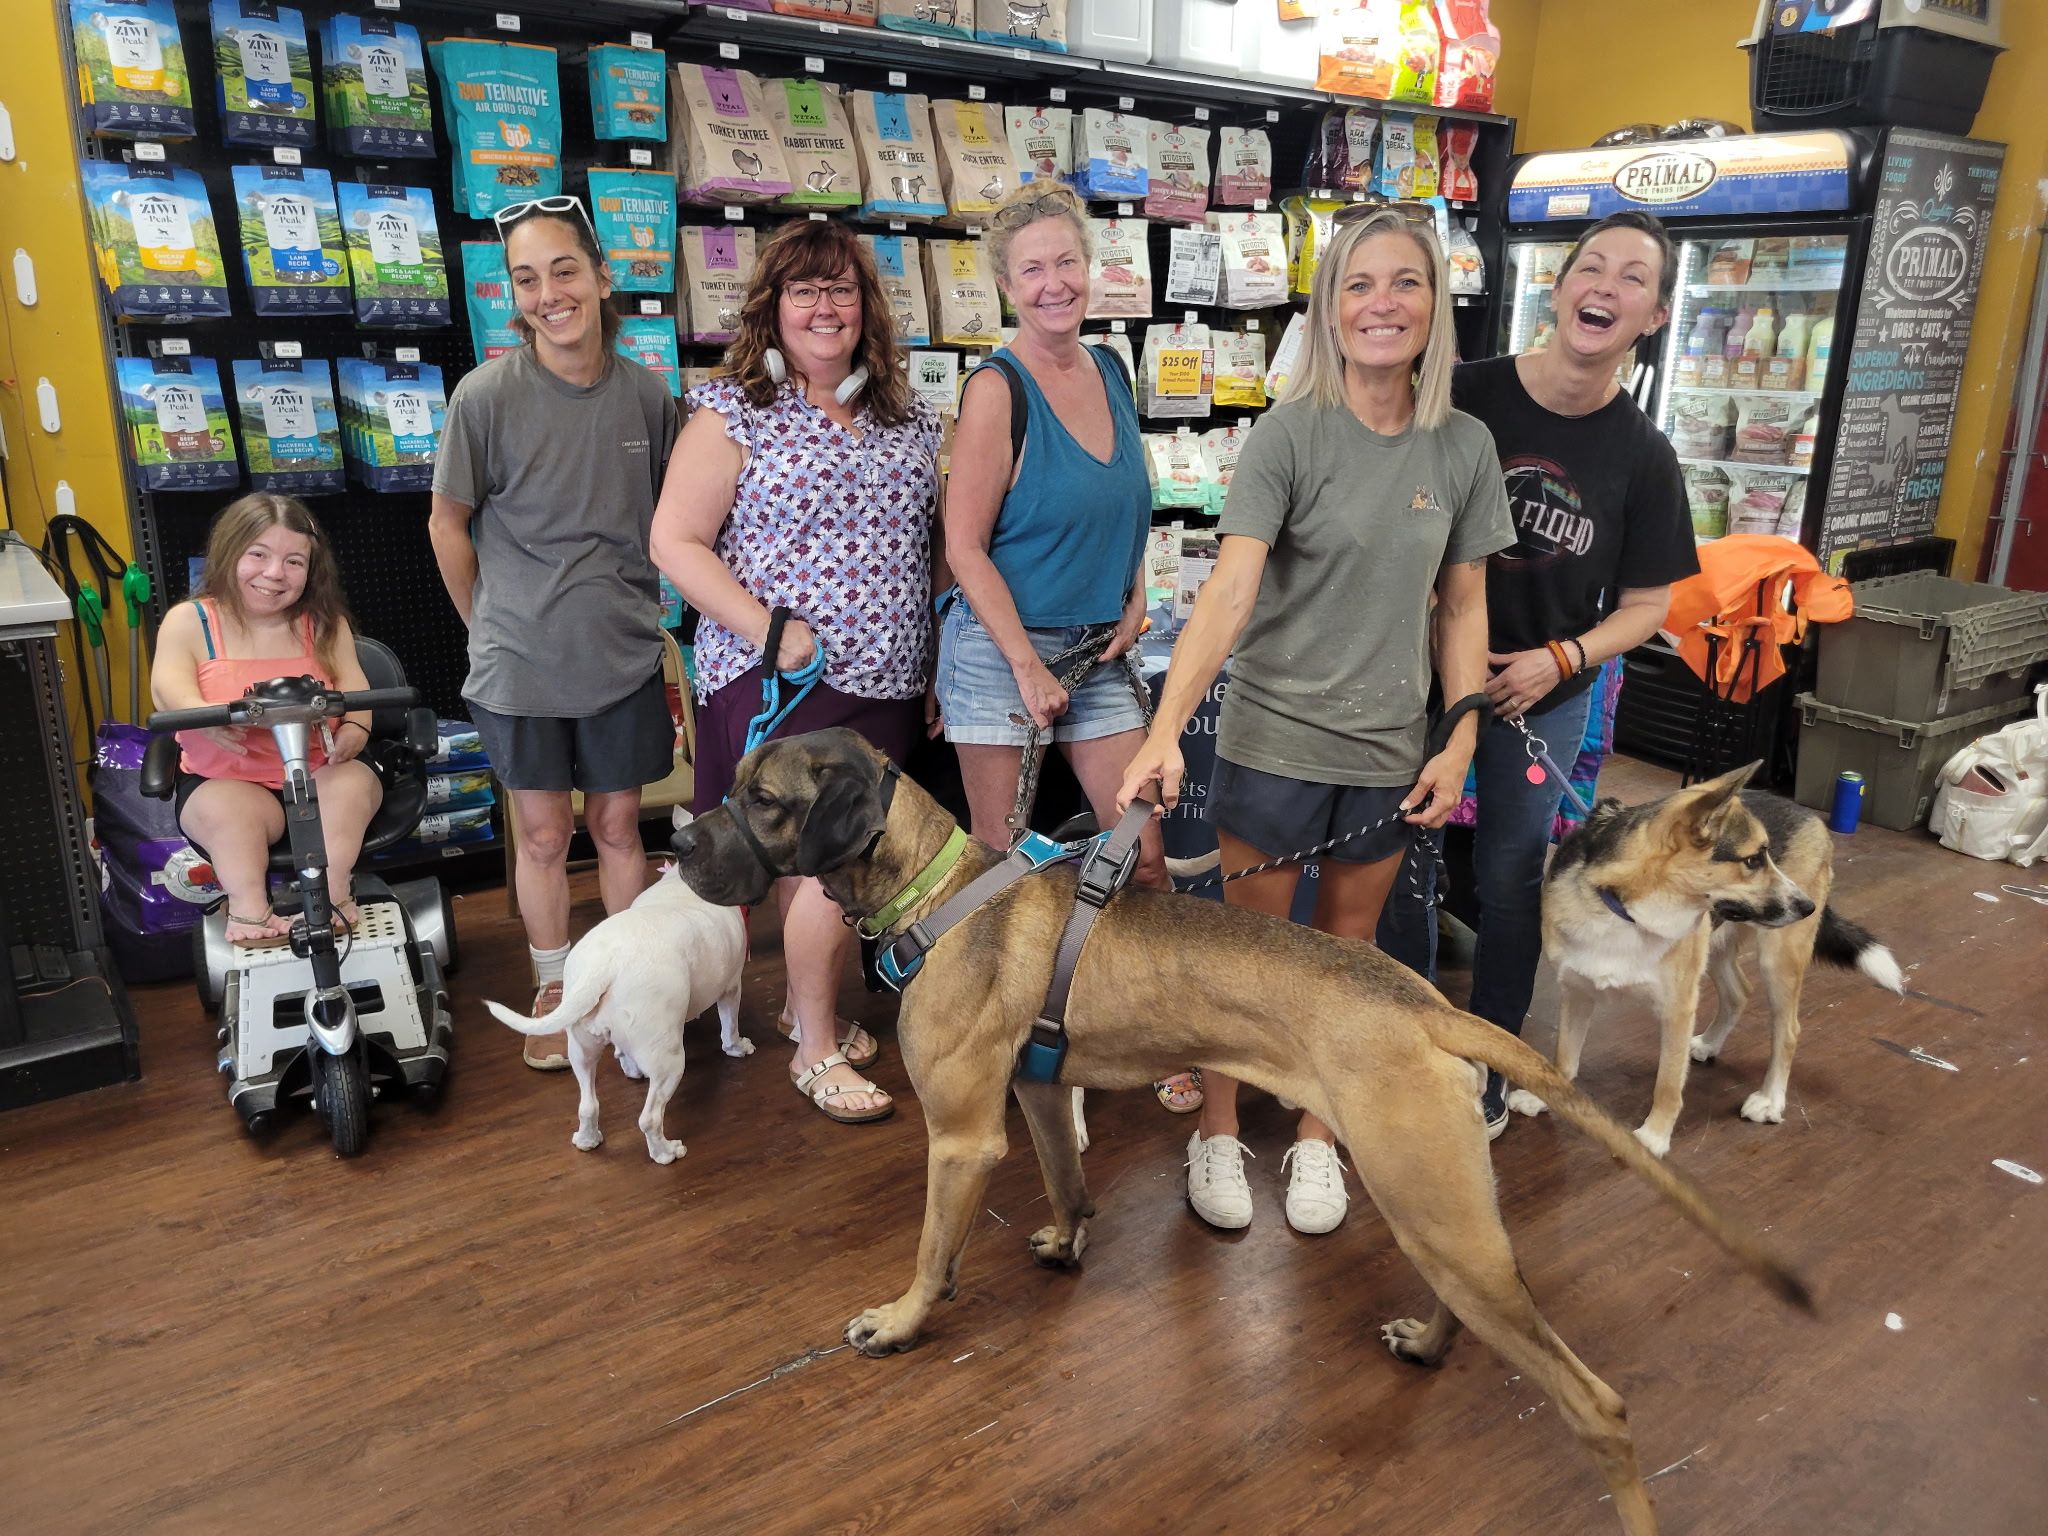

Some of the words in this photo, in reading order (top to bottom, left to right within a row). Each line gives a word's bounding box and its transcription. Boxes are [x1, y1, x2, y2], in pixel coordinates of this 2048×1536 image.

[113, 25, 149, 37] ZIWI
[122, 37, 144, 45] Peak
[247, 40, 279, 52] ZIWI
[254, 52, 274, 60] Peak
[367, 55, 397, 67] ZIWI
[375, 66, 393, 74] Peak
[457, 81, 549, 106] RAWTERNATIVE
[475, 102, 490, 112] AIR
[492, 102, 516, 115] DRIED
[517, 104, 537, 117] FOOD
[717, 102, 742, 110] VITAL
[707, 123, 736, 139] TURKEY
[738, 129, 770, 141] ENTREE
[783, 136, 812, 149] RABBIT
[814, 138, 846, 150] ENTREE
[1349, 138, 1370, 147] BEARS
[878, 150, 896, 161] BEEF
[978, 155, 1007, 165] ENTREE
[1162, 153, 1192, 162] NUGGETS
[1887, 157, 1912, 168] LIVING
[1626, 163, 1705, 188] PRIMAL
[1885, 172, 1907, 183] FOODS
[1968, 168, 1998, 180] THRIVING
[1652, 187, 1673, 195] FOODS
[1980, 184, 1995, 194] PETS
[140, 203, 178, 214] ZIWI
[271, 205, 306, 216] ZIWI
[599, 196, 670, 215] RAWTERNATIVE
[1921, 198, 1955, 223] Quality
[149, 215, 174, 223] Peak
[280, 216, 302, 224] Peak
[376, 221, 408, 232] ZIWI
[384, 232, 405, 240] Peak
[1101, 248, 1130, 257] NUGGETS
[1897, 247, 1960, 278] PRIMAL
[701, 281, 726, 291] TURKEY
[1903, 279, 1914, 289] PET
[1916, 279, 1934, 289] FOODS
[968, 290, 988, 298] ENTREE
[1885, 307, 1916, 319] Wholesome
[1917, 308, 1928, 318] Raw
[1928, 309, 1943, 319] Foods
[1891, 322, 1914, 339] DOGS
[1921, 322, 1941, 339] CATS
[1162, 356, 1180, 367] $25
[1182, 356, 1198, 369] Off
[1852, 351, 1899, 368] SUPERIOR
[1848, 370, 1925, 392] INGREDIENTS
[162, 393, 194, 403] ZIWI
[270, 395, 304, 405] ZIWI
[1846, 397, 1881, 409] TAURINE
[169, 403, 190, 411] Peak
[393, 400, 421, 408] ZIWI
[400, 407, 417, 415] Peak
[1849, 422, 1882, 434] PHEASANT
[1836, 413, 1851, 458] PORK
[1920, 461, 1944, 476] FARM
[1848, 488, 1868, 498] RABBIT
[1905, 477, 1942, 500] FRESH
[1890, 476, 1908, 538] CHICKEN
[1830, 514, 1859, 531] ORGANIC
[1859, 510, 1889, 526] BROCCOLI
[1519, 500, 1594, 556] FLOYD
[1834, 533, 1860, 546] VENISON
[1184, 714, 1219, 735] ou
[425, 815, 444, 825] ZIWI
[1303, 864, 1320, 879] rg
